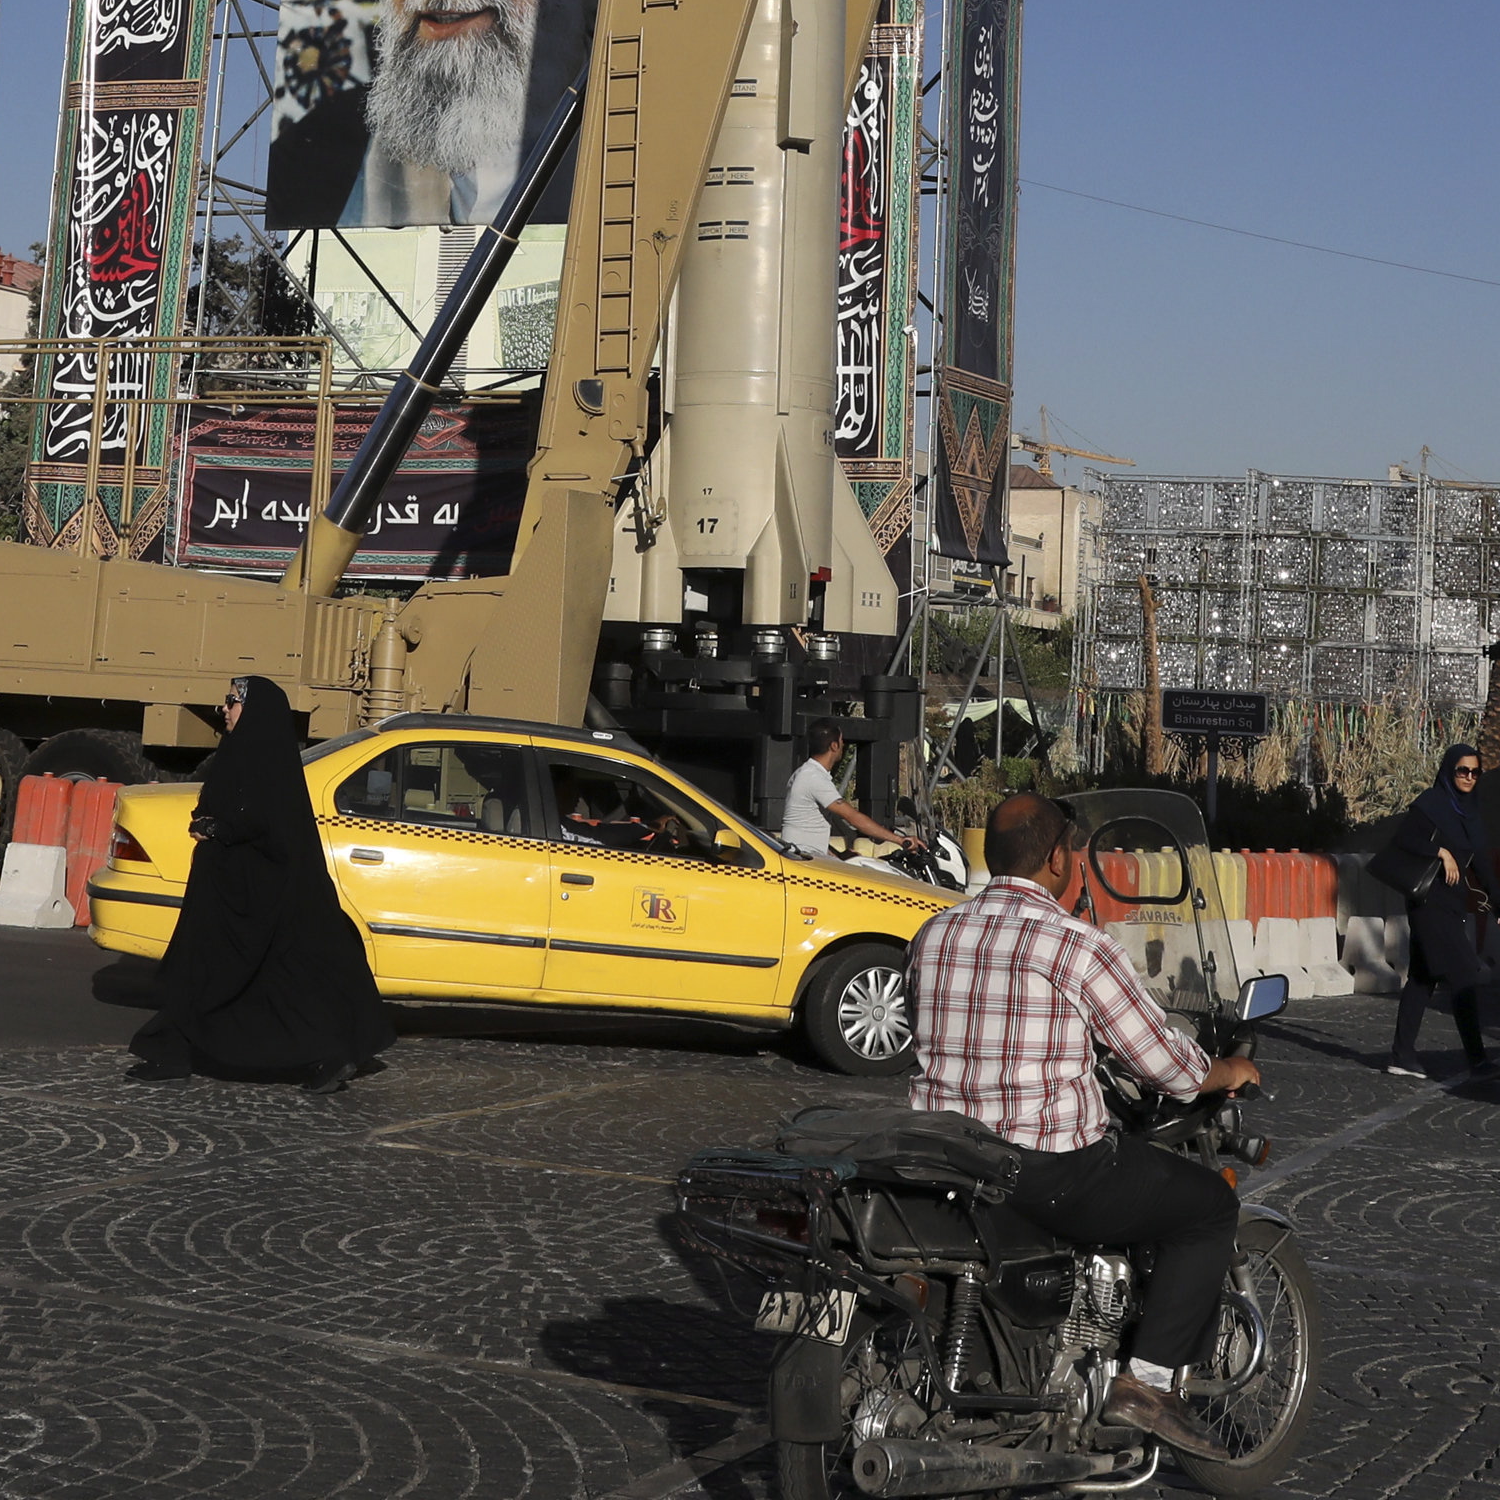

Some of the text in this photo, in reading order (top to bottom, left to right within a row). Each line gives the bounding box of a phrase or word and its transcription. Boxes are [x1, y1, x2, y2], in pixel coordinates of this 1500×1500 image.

[702, 487, 713, 496] 17
[204, 478, 250, 529] ایم
[366, 495, 419, 534] قدر
[432, 501, 460, 531] به
[696, 517, 719, 535] 17
[1172, 695, 1256, 711] میدان بهارستان
[1175, 714, 1252, 730] Baharestan Sq
